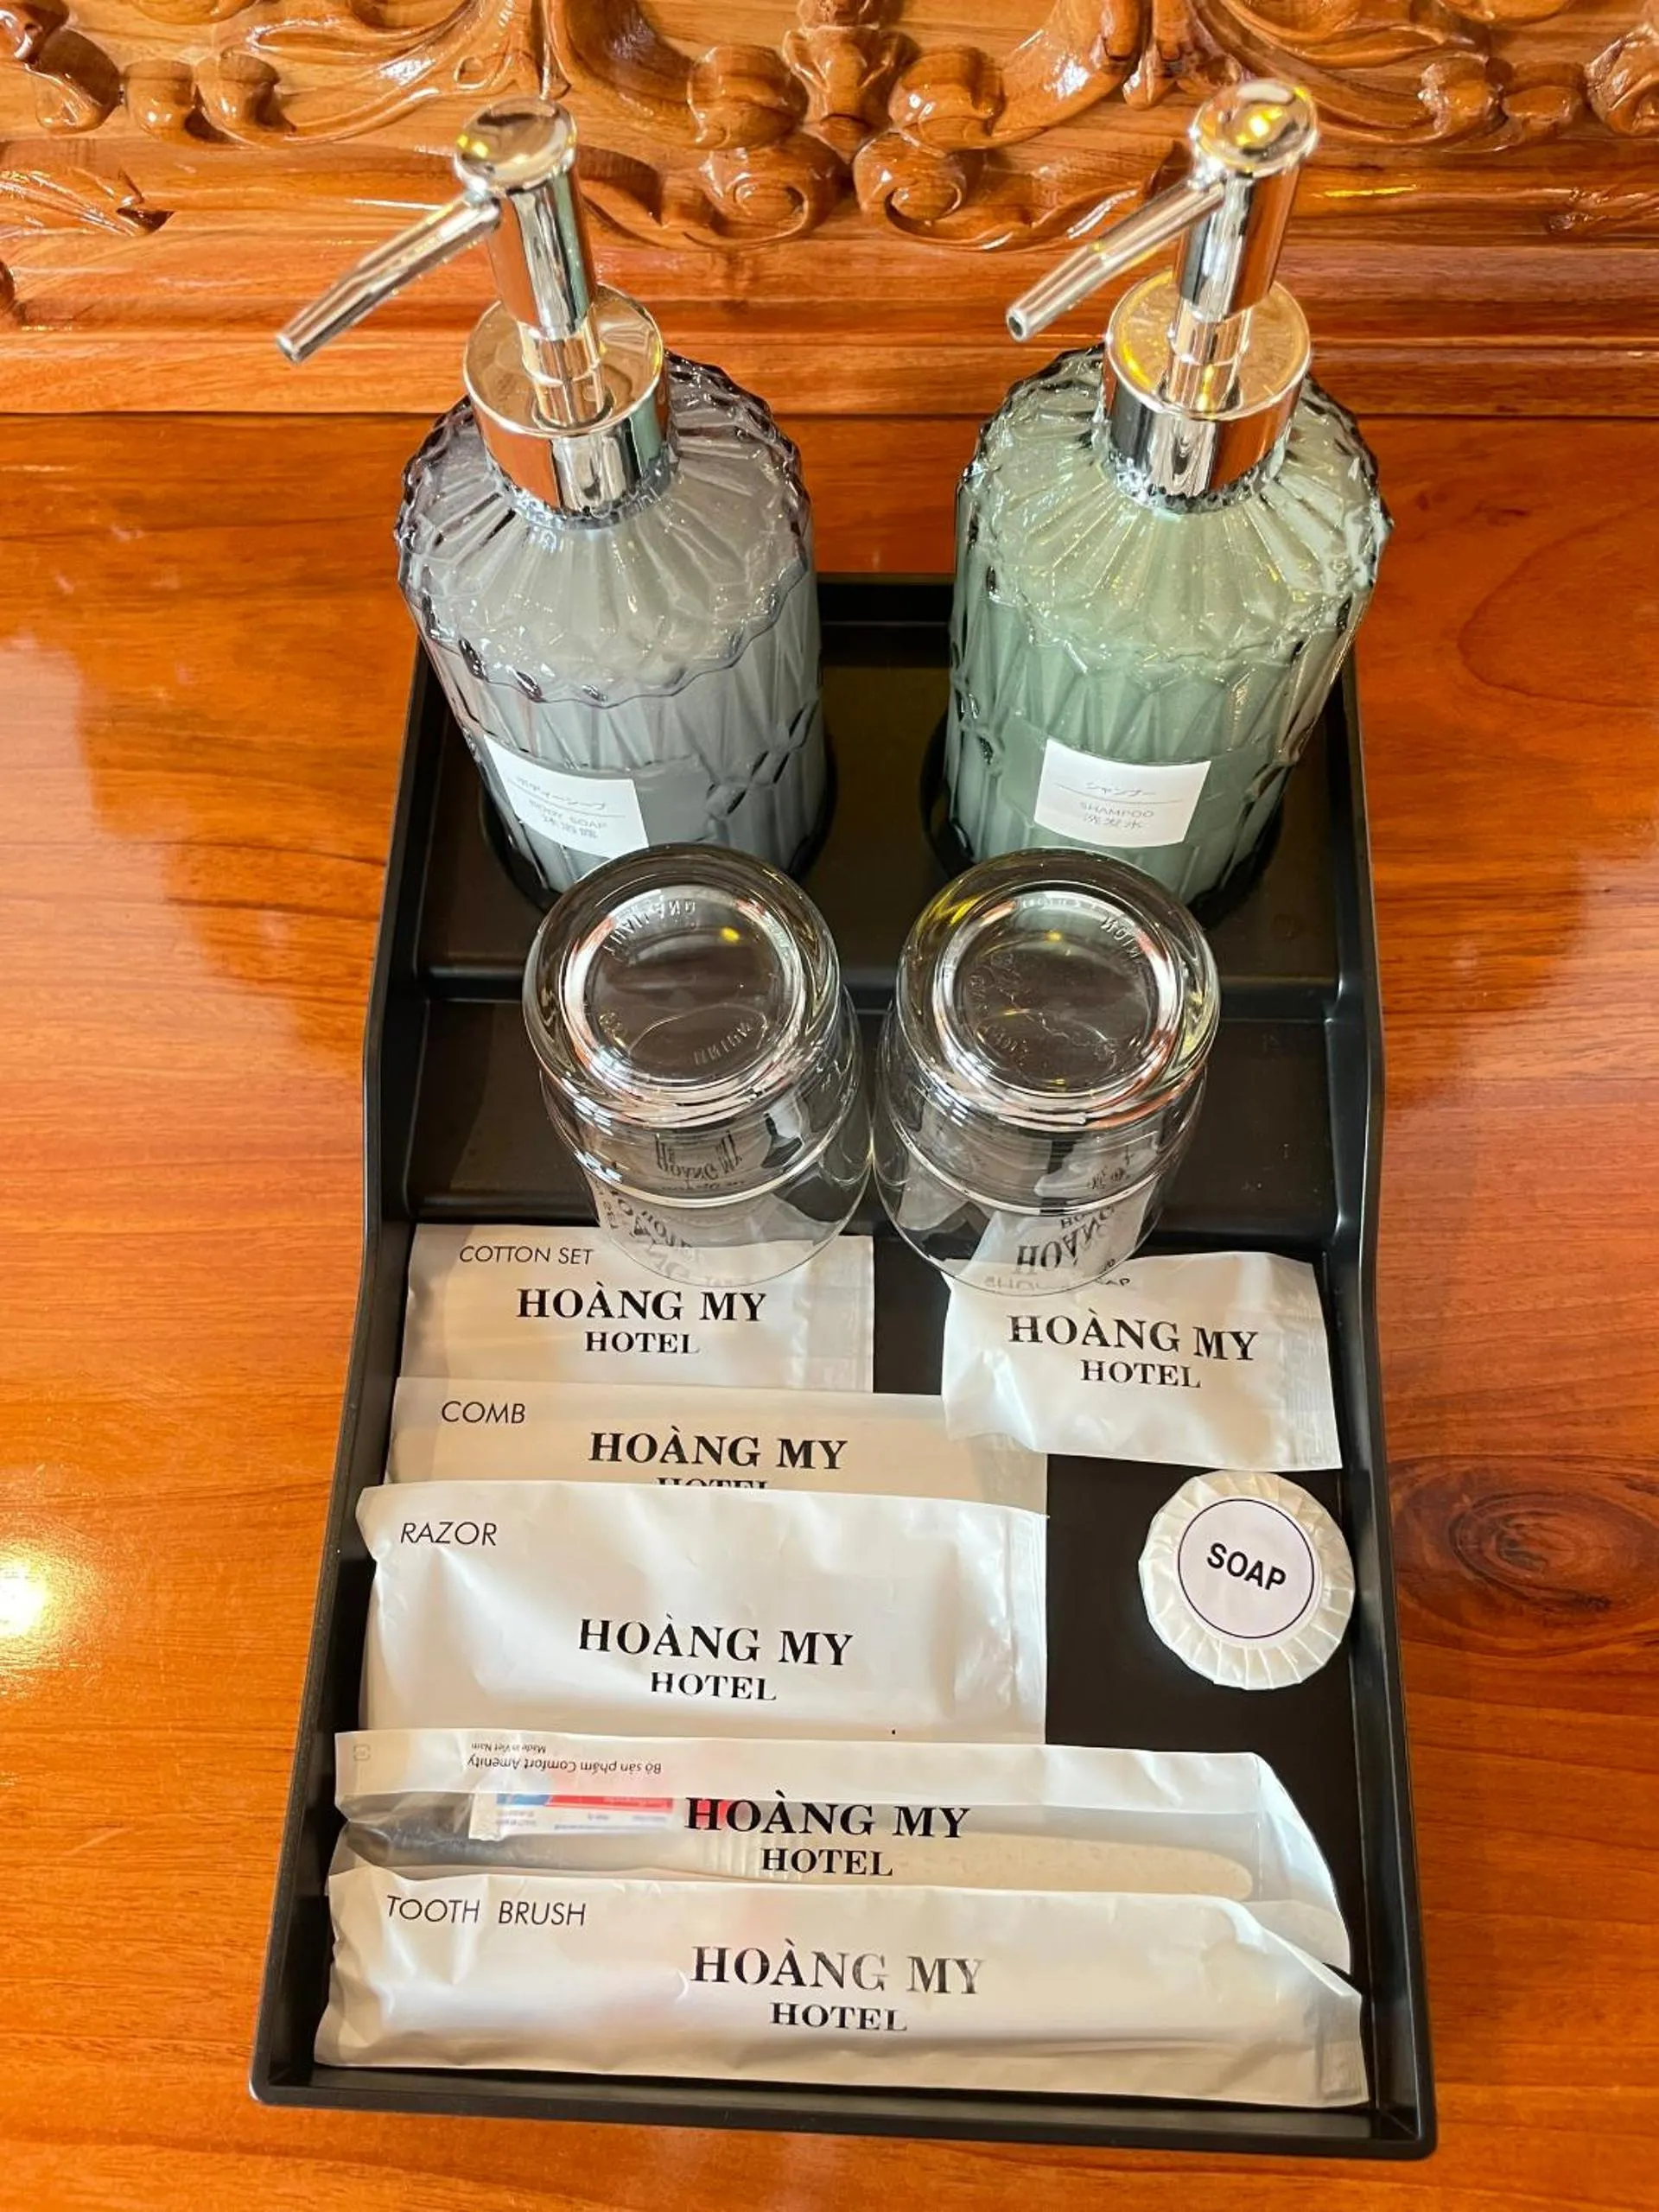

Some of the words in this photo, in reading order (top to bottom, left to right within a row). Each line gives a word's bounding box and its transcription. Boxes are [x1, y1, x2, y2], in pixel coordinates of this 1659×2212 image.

[459, 1245, 550, 1264] COTTON
[557, 1248, 594, 1266] SET
[517, 1281, 684, 1321] HOÀNG
[699, 1291, 767, 1322] MY
[585, 1331, 700, 1354] HOTEL
[1007, 1308, 1181, 1352] HOÀNG
[1192, 1326, 1259, 1361] MY
[1081, 1359, 1201, 1389] HOTEL
[441, 1400, 526, 1424] COMB
[588, 1425, 761, 1467] HOÀNG
[775, 1438, 849, 1470] MY
[400, 1521, 498, 1547] RAZOR
[1206, 1542, 1287, 1591] SOAP
[578, 1612, 762, 1662] HOÀNG
[778, 1630, 854, 1667] MY
[650, 1671, 777, 1700] HOTEL
[467, 1754, 521, 1770] Amenity
[524, 1756, 576, 1771] Comfort
[684, 1789, 875, 1836] HOÀNG
[892, 1805, 971, 1839] MY
[760, 1847, 893, 1877] HOTEL
[387, 1895, 480, 1923] TOOTH
[498, 1900, 587, 1926] BRUSH
[690, 1938, 889, 1992] HOÀNG
[906, 1955, 986, 1994] MY
[769, 2001, 907, 2031] HOTEL
